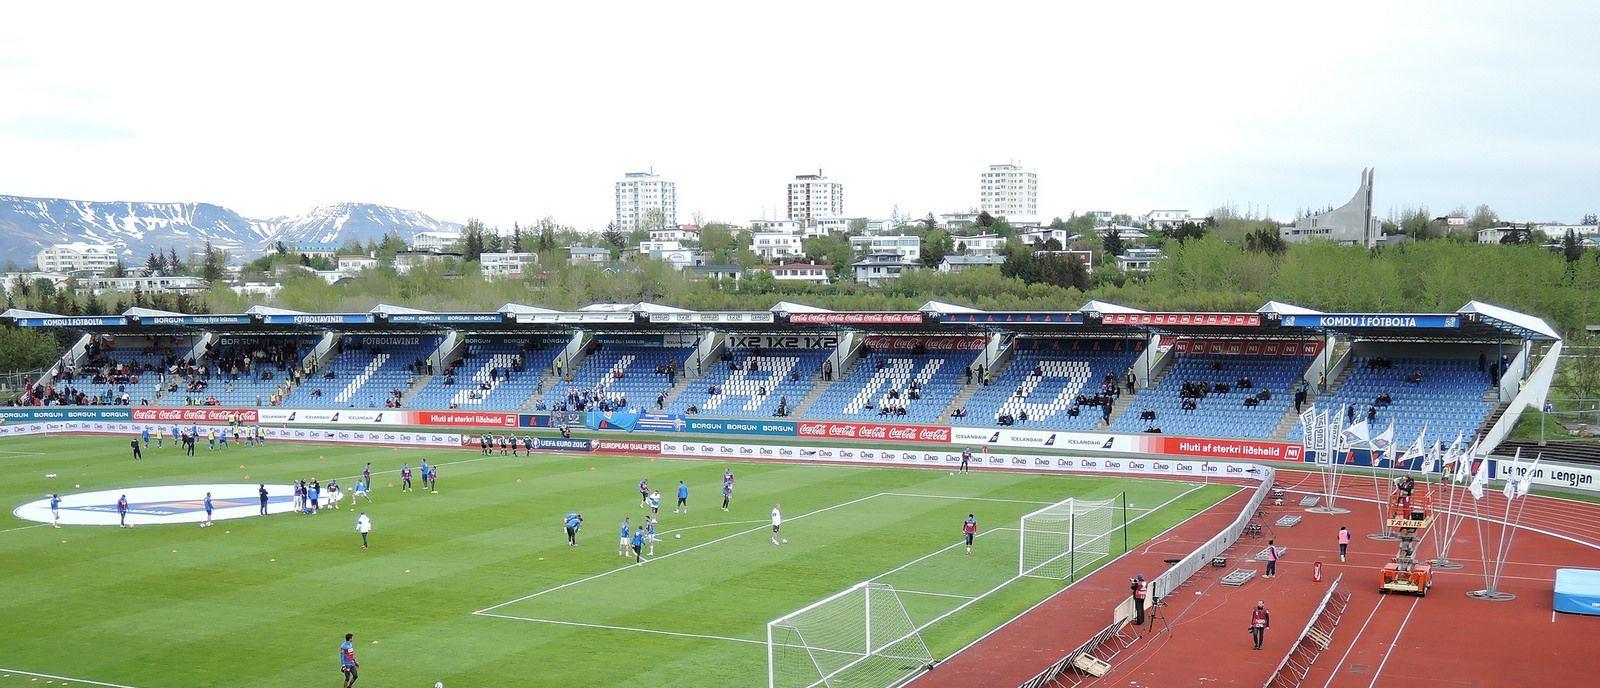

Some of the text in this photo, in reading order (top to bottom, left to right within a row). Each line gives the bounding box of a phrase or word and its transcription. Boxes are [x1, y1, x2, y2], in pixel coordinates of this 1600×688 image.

[1320, 317, 1358, 326] KOMDU
[1367, 316, 1416, 326] FÓTBOLTA
[730, 336, 760, 348] 1X2
[766, 336, 798, 348] 1X2
[804, 336, 838, 348] 1X2
[1180, 443, 1280, 456] Hluti af sterkri liðsheild
[1552, 470, 1593, 486] Lengjan
